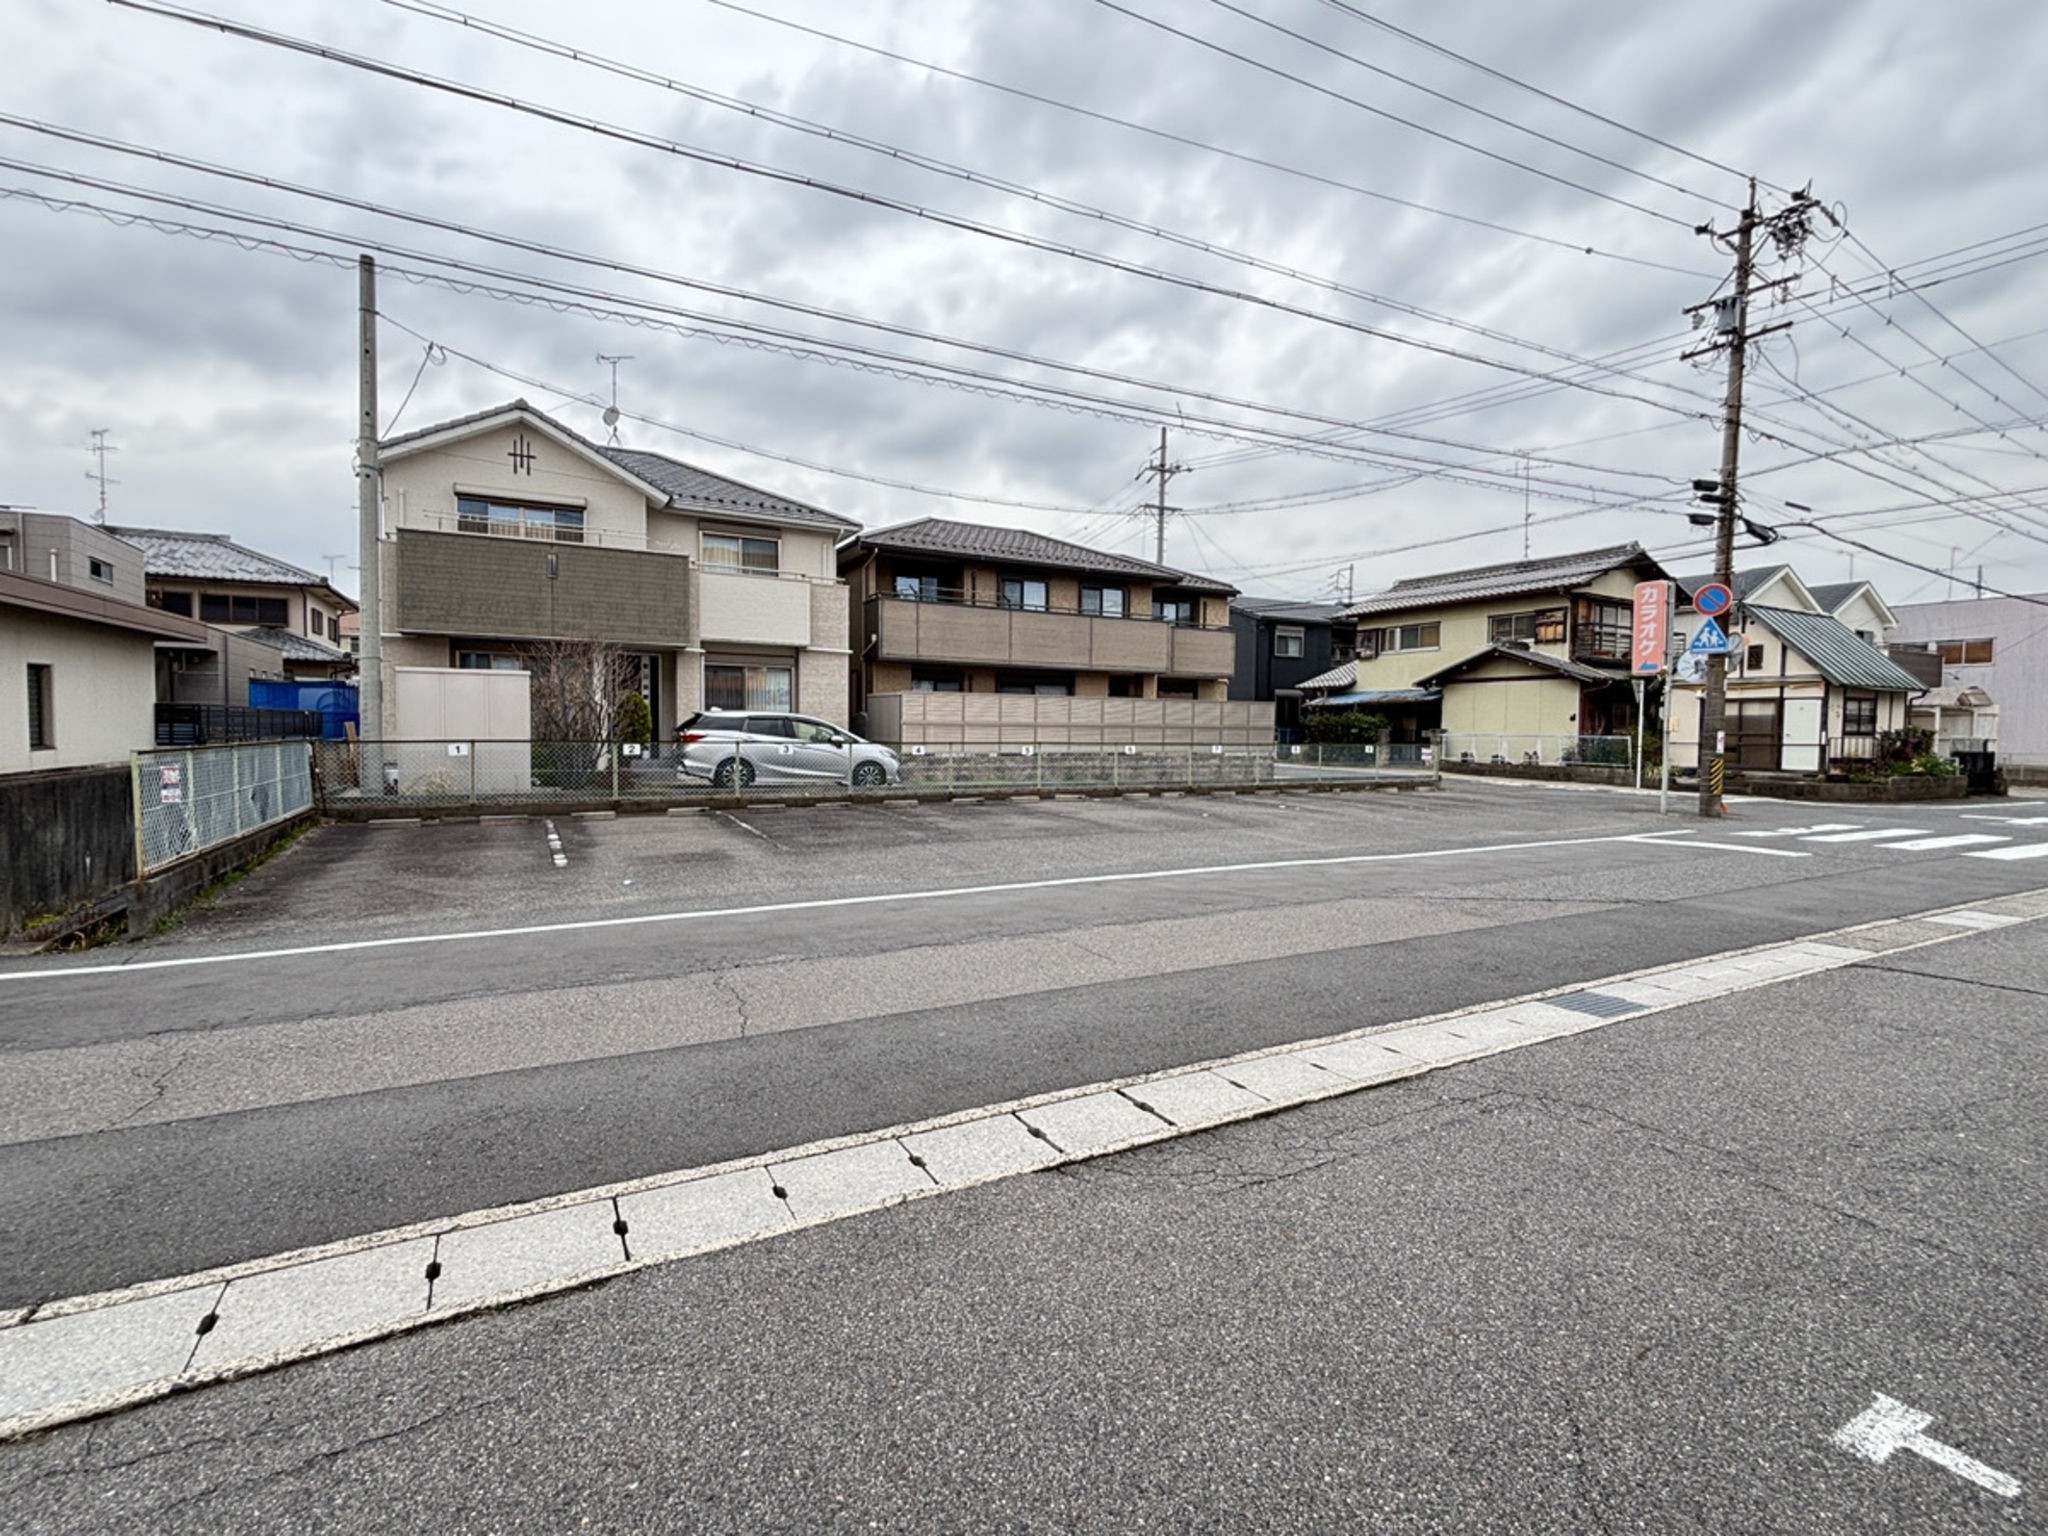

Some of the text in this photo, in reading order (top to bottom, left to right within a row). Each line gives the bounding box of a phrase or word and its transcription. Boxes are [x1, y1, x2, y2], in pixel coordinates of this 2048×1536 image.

[1639, 587, 1658, 656] カラオケ
[456, 745, 461, 754] 1
[627, 745, 636, 754] 2
[783, 745, 790, 754] 3
